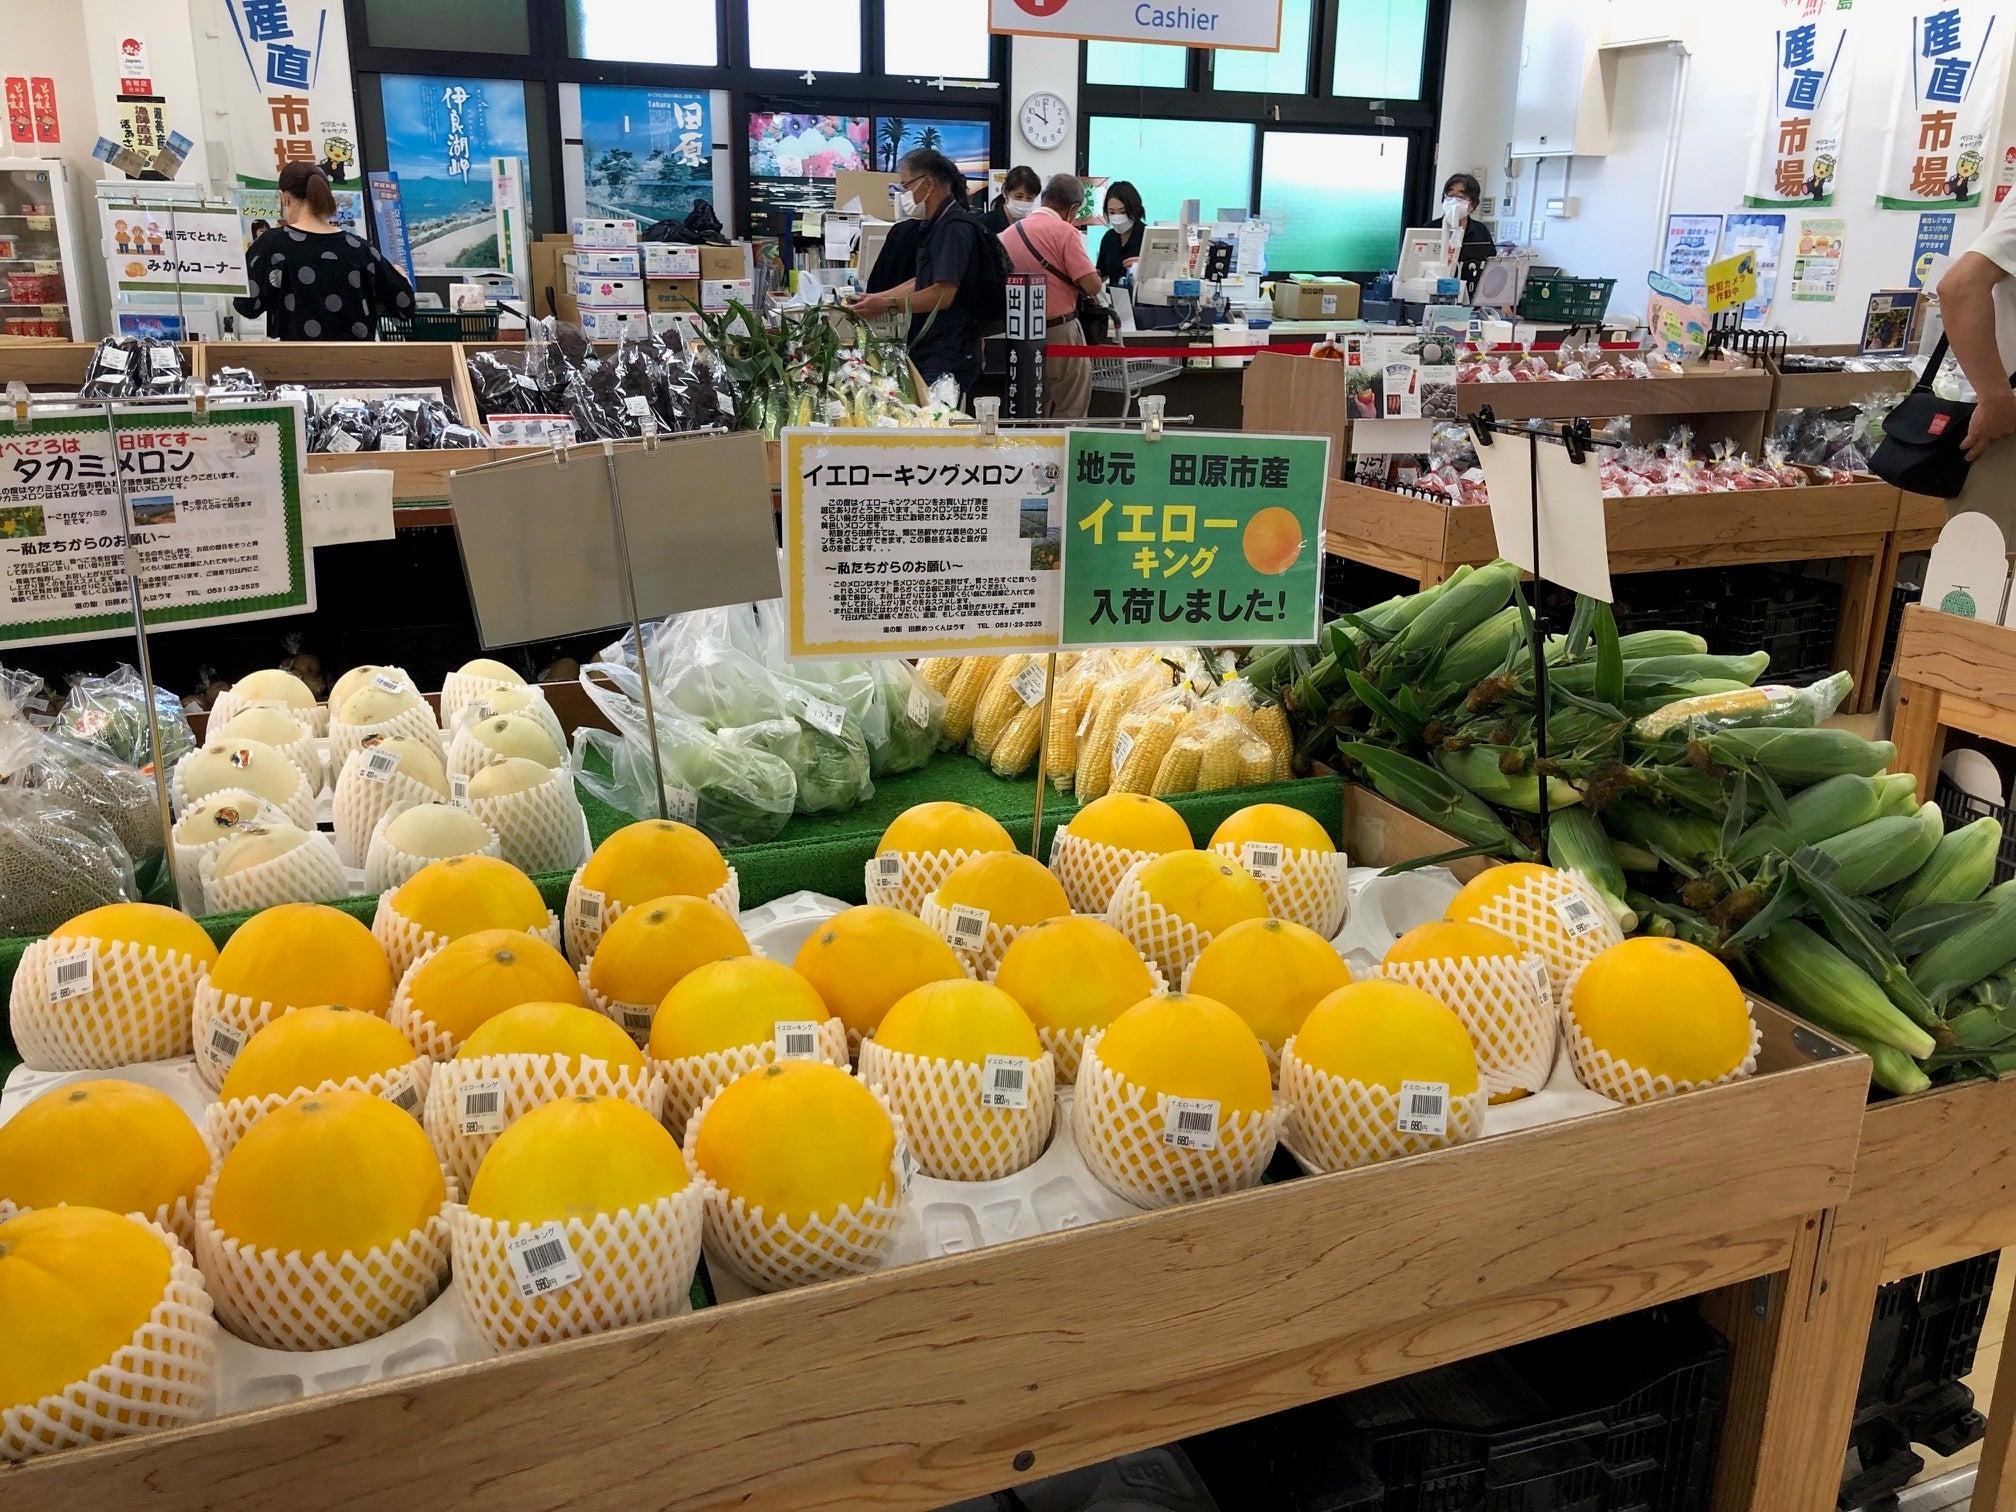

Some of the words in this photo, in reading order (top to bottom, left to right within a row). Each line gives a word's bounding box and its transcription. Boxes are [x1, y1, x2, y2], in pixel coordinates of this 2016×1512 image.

[1134, 3, 1219, 32] Cashier
[441, 86, 471, 185] 伊良湖岬
[671, 102, 708, 168] 田原
[165, 230, 228, 243] 地元でとれた
[147, 259, 242, 274] みかんコーナー
[1707, 273, 1746, 295] 防犯カメラ
[1716, 287, 1739, 303] 作動中
[1009, 288, 1021, 337] 出口
[1033, 288, 1044, 337] 出口
[0, 438, 80, 458] べごろは
[13, 449, 195, 484] タカミメロン
[802, 464, 1024, 487] イエローキングメロン
[1076, 449, 1136, 485] 地元
[1169, 453, 1290, 489] 田原市産
[1078, 498, 1238, 545] イエロー
[1132, 545, 1219, 579] キング
[186, 589, 201, 597] TEL
[207, 582, 260, 595] 0531-23-2525
[1089, 587, 1287, 626] 入荷しました!
[995, 621, 1042, 629] 0531-23-2525
[777, 1024, 813, 1032] イエローキング
[988, 1059, 1024, 1067] イエローキング
[459, 1081, 498, 1092] イエローキング
[1403, 1083, 1443, 1093] イエローキング
[1171, 1100, 1214, 1111] イエローキング
[507, 1227, 554, 1250] イエローキング
